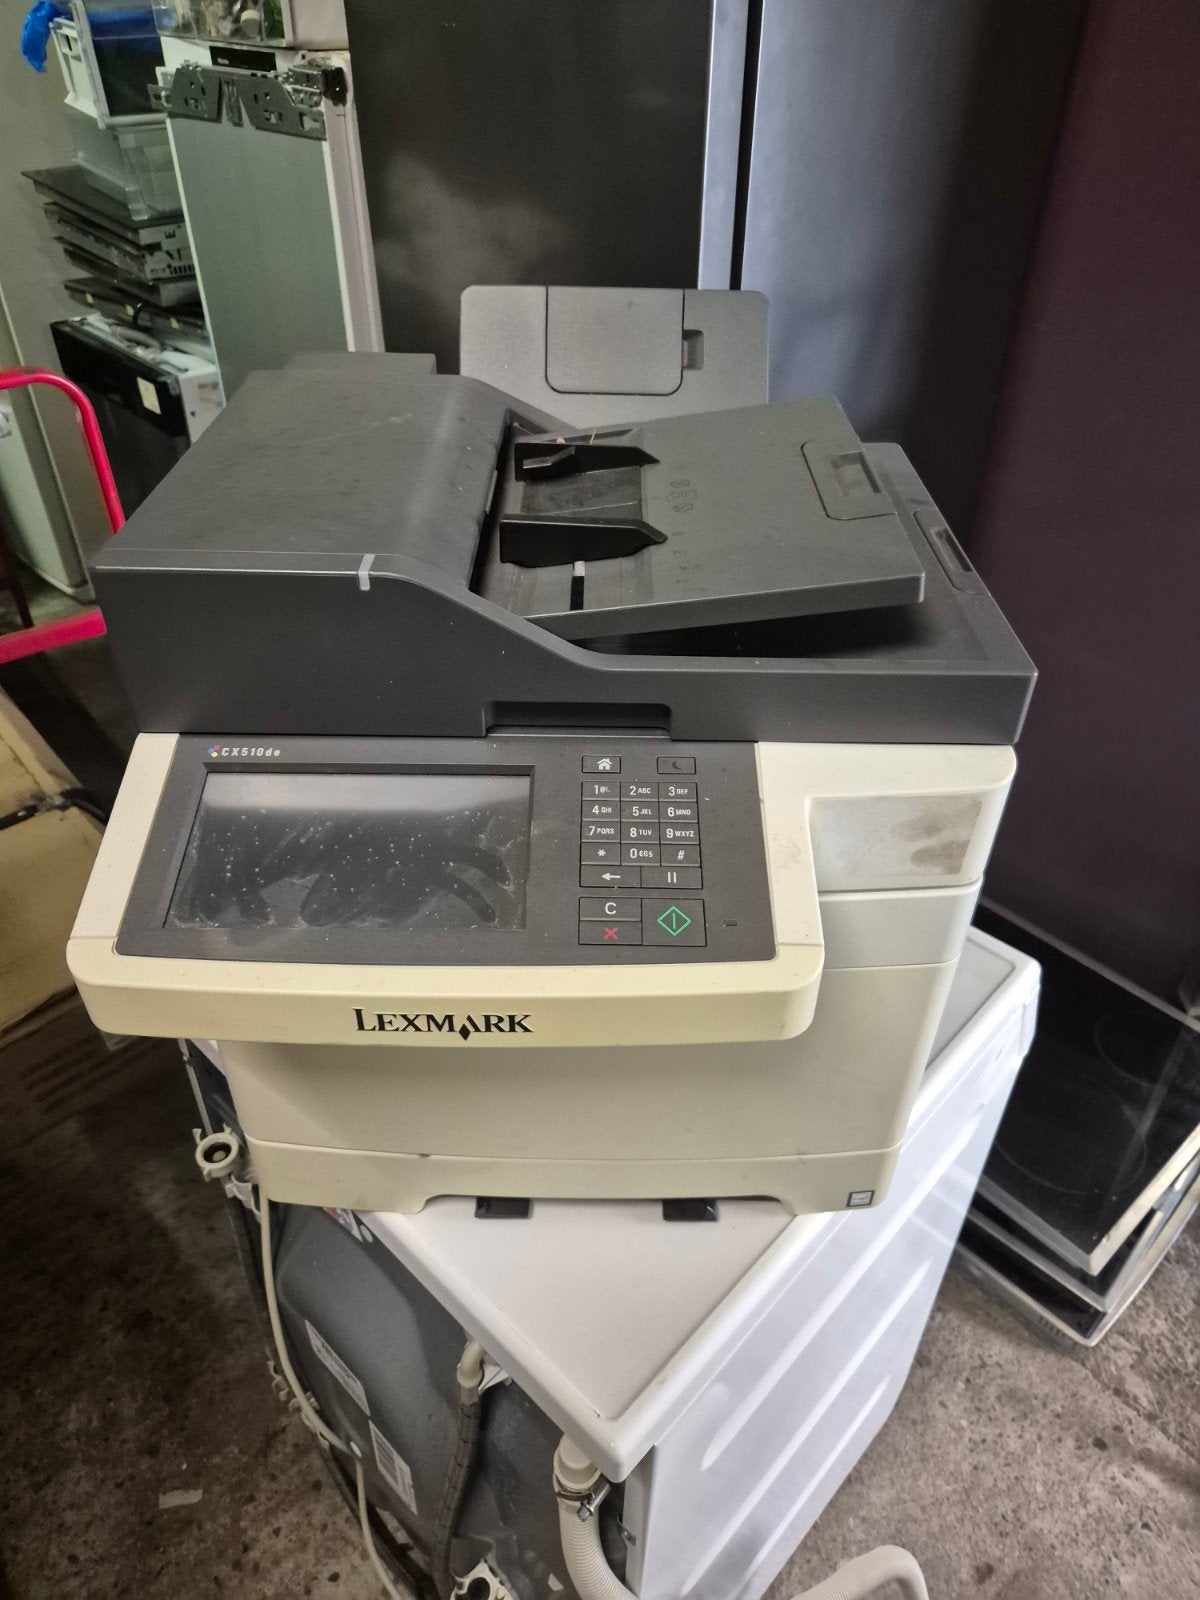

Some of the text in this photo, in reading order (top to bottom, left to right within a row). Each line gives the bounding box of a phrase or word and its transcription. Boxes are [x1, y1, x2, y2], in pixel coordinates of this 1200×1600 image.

[221, 747, 281, 757] CX510de
[604, 902, 617, 915] C
[352, 1007, 535, 1041] LEXMARK
